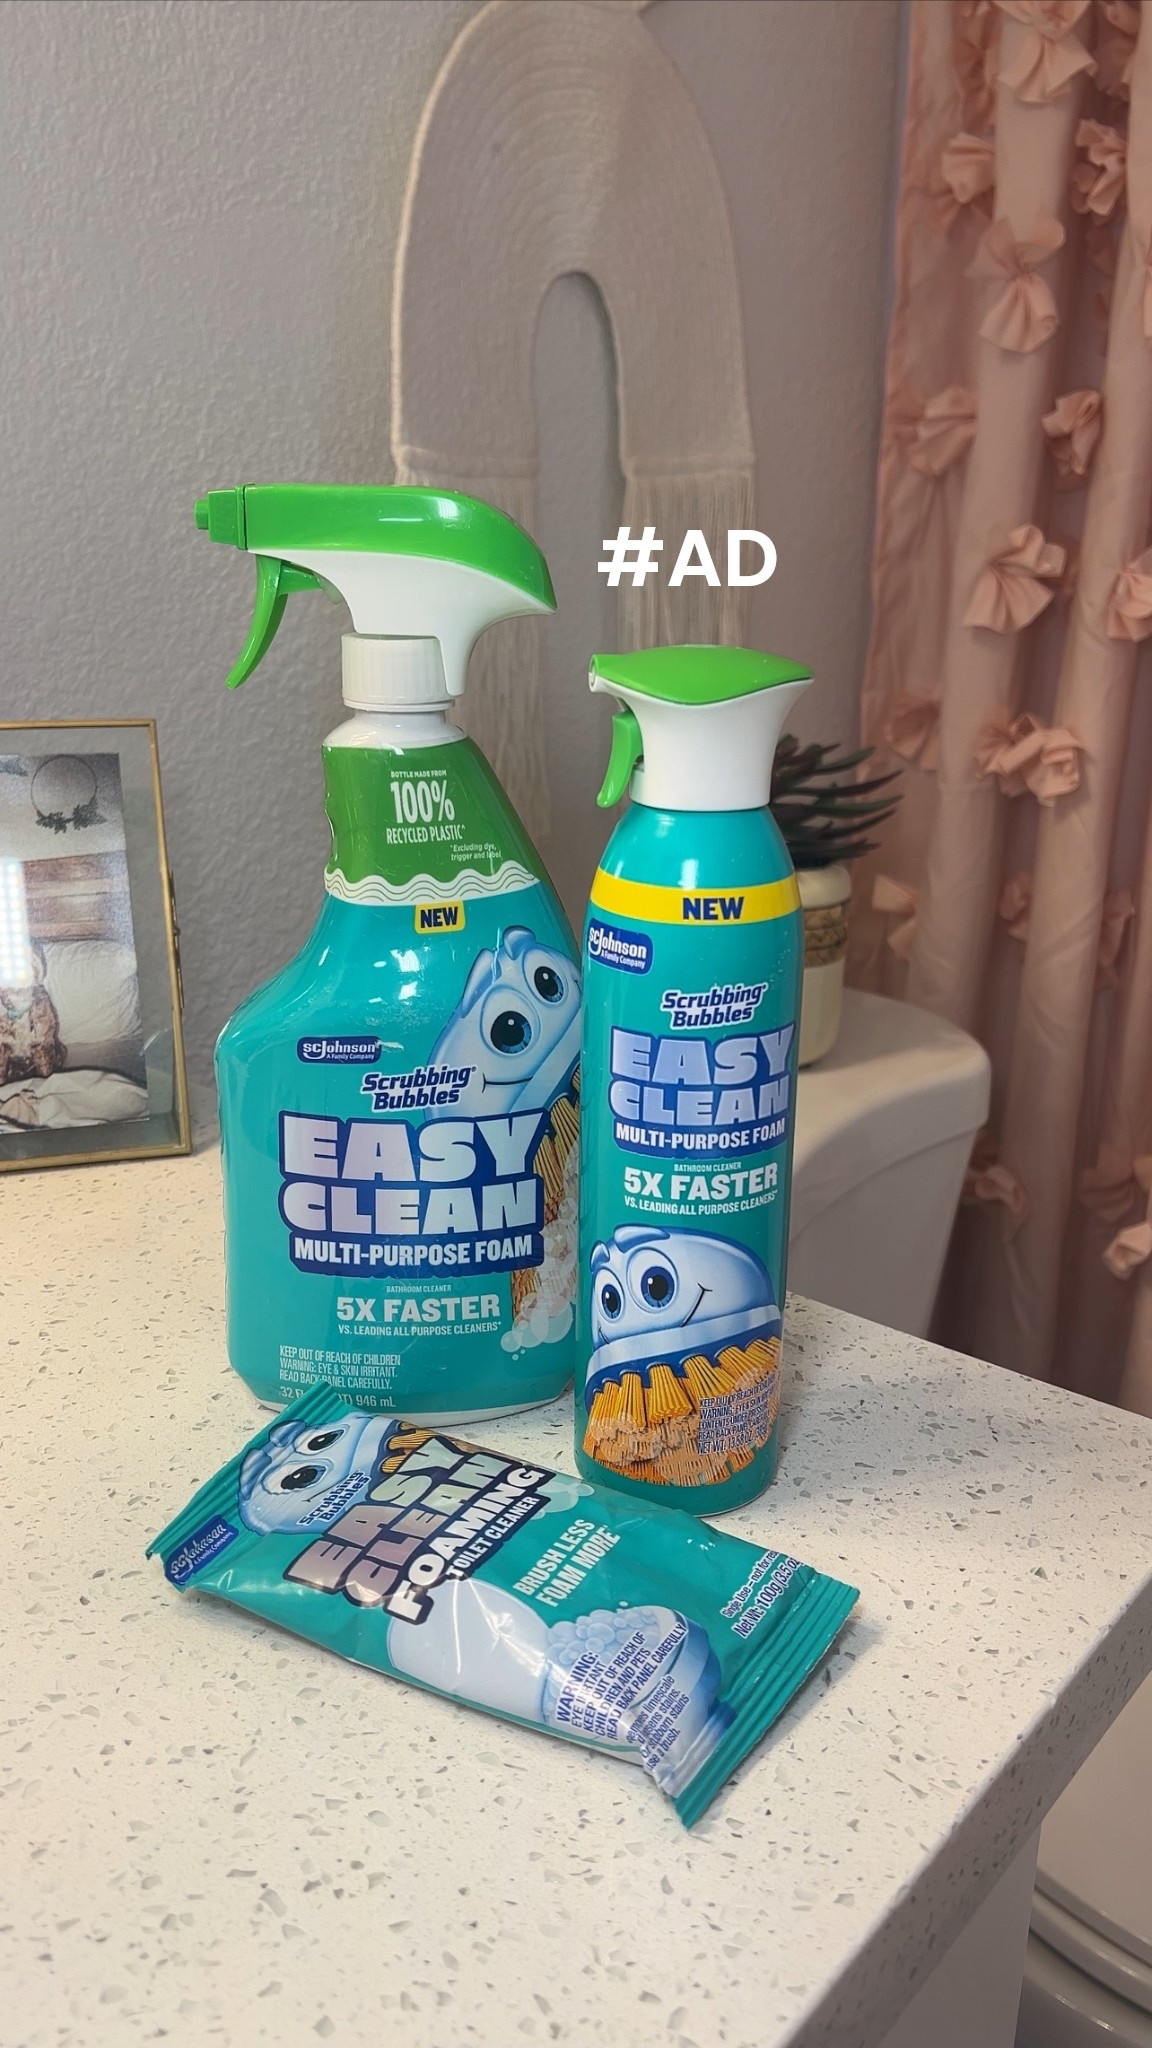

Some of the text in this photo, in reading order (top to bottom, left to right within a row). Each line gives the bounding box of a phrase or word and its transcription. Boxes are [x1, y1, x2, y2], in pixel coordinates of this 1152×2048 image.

[431, 769, 447, 777] FROM
[390, 779, 455, 824] 100%
[386, 827, 429, 844] RECYCLED
[451, 853, 472, 861] trigger
[421, 906, 458, 928] NEW
[683, 897, 744, 921] NEW
[605, 950, 619, 964] Family
[619, 954, 646, 970] Company
[663, 984, 762, 1009] Scrubbing
[672, 1005, 752, 1028] Bubbles
[612, 1022, 796, 1086] EASY
[362, 1067, 471, 1092] Scrubbing
[373, 1087, 459, 1110] Bubbles
[610, 1074, 791, 1126] CLEAN
[616, 1117, 786, 1150] MULTI-PURPOSE FOAM
[283, 1112, 544, 1183] EASY
[674, 1162, 742, 1173] BATHROOM CLEANER
[624, 1162, 777, 1201] 5X FASTER
[283, 1178, 537, 1235] CLEAN
[624, 1195, 638, 1208] VS.
[639, 1200, 679, 1215] LEADING
[679, 1204, 696, 1215] ALL
[699, 1201, 739, 1216] PURPOSE
[295, 1234, 532, 1266] MULTI-PURPOSE FOAM
[386, 1284, 451, 1293] BATHROOM CLEANER
[336, 1294, 500, 1322] 5X FASTER
[338, 1325, 353, 1335] VS.
[354, 1326, 391, 1336] LEADING
[393, 1327, 409, 1336] ALL
[411, 1326, 452, 1336] PURPOSE
[280, 1345, 297, 1358] KEEP
[299, 1348, 313, 1360] OUT
[315, 1350, 325, 1361] OF
[326, 1351, 351, 1364] REACH
[352, 1353, 362, 1365] OF
[280, 1357, 398, 1378] WARNING: EYE & SKIN IRRITANT.
[280, 1369, 299, 1383] READ
[300, 1372, 320, 1385] BACK
[348, 1377, 392, 1390] CAREFULLY.
[280, 1386, 294, 1399] 32
[356, 1395, 377, 1407] 946
[380, 1396, 396, 1407] mL
[700, 1397, 717, 1407] KEEP
[717, 1395, 730, 1406] OUT
[699, 1416, 731, 1430] CONTENTS
[698, 1441, 712, 1455] NET
[299, 1472, 364, 1525] Scrubbing
[317, 1476, 370, 1521] Bubbles
[288, 1437, 465, 1589] EASY
[345, 1453, 513, 1603] CLEAN
[445, 1496, 540, 1577] TOILET CLEANER
[387, 1467, 546, 1621] FOAMING
[513, 1519, 595, 1595] BRUSH LESS
[535, 1564, 587, 1607] FOAM
[721, 1600, 742, 1618] Single
[736, 1586, 751, 1602] Use
[751, 1569, 763, 1581] not
[758, 1560, 770, 1572] for
[733, 1618, 754, 1637] Net
[756, 1582, 783, 1607] 100g
[557, 1652, 599, 1722] WARNING:
[584, 1631, 646, 1732] KEEP OUT OF REACH OF
[595, 1647, 651, 1737] CHILDREN AND PETS
[607, 1623, 687, 1741] READ BACK PANEL CAREFULLY
[642, 1675, 675, 1713] limescale
[659, 1688, 681, 1714] stains.
[669, 1693, 690, 1720] stains
[572, 1703, 584, 1727] EYE
